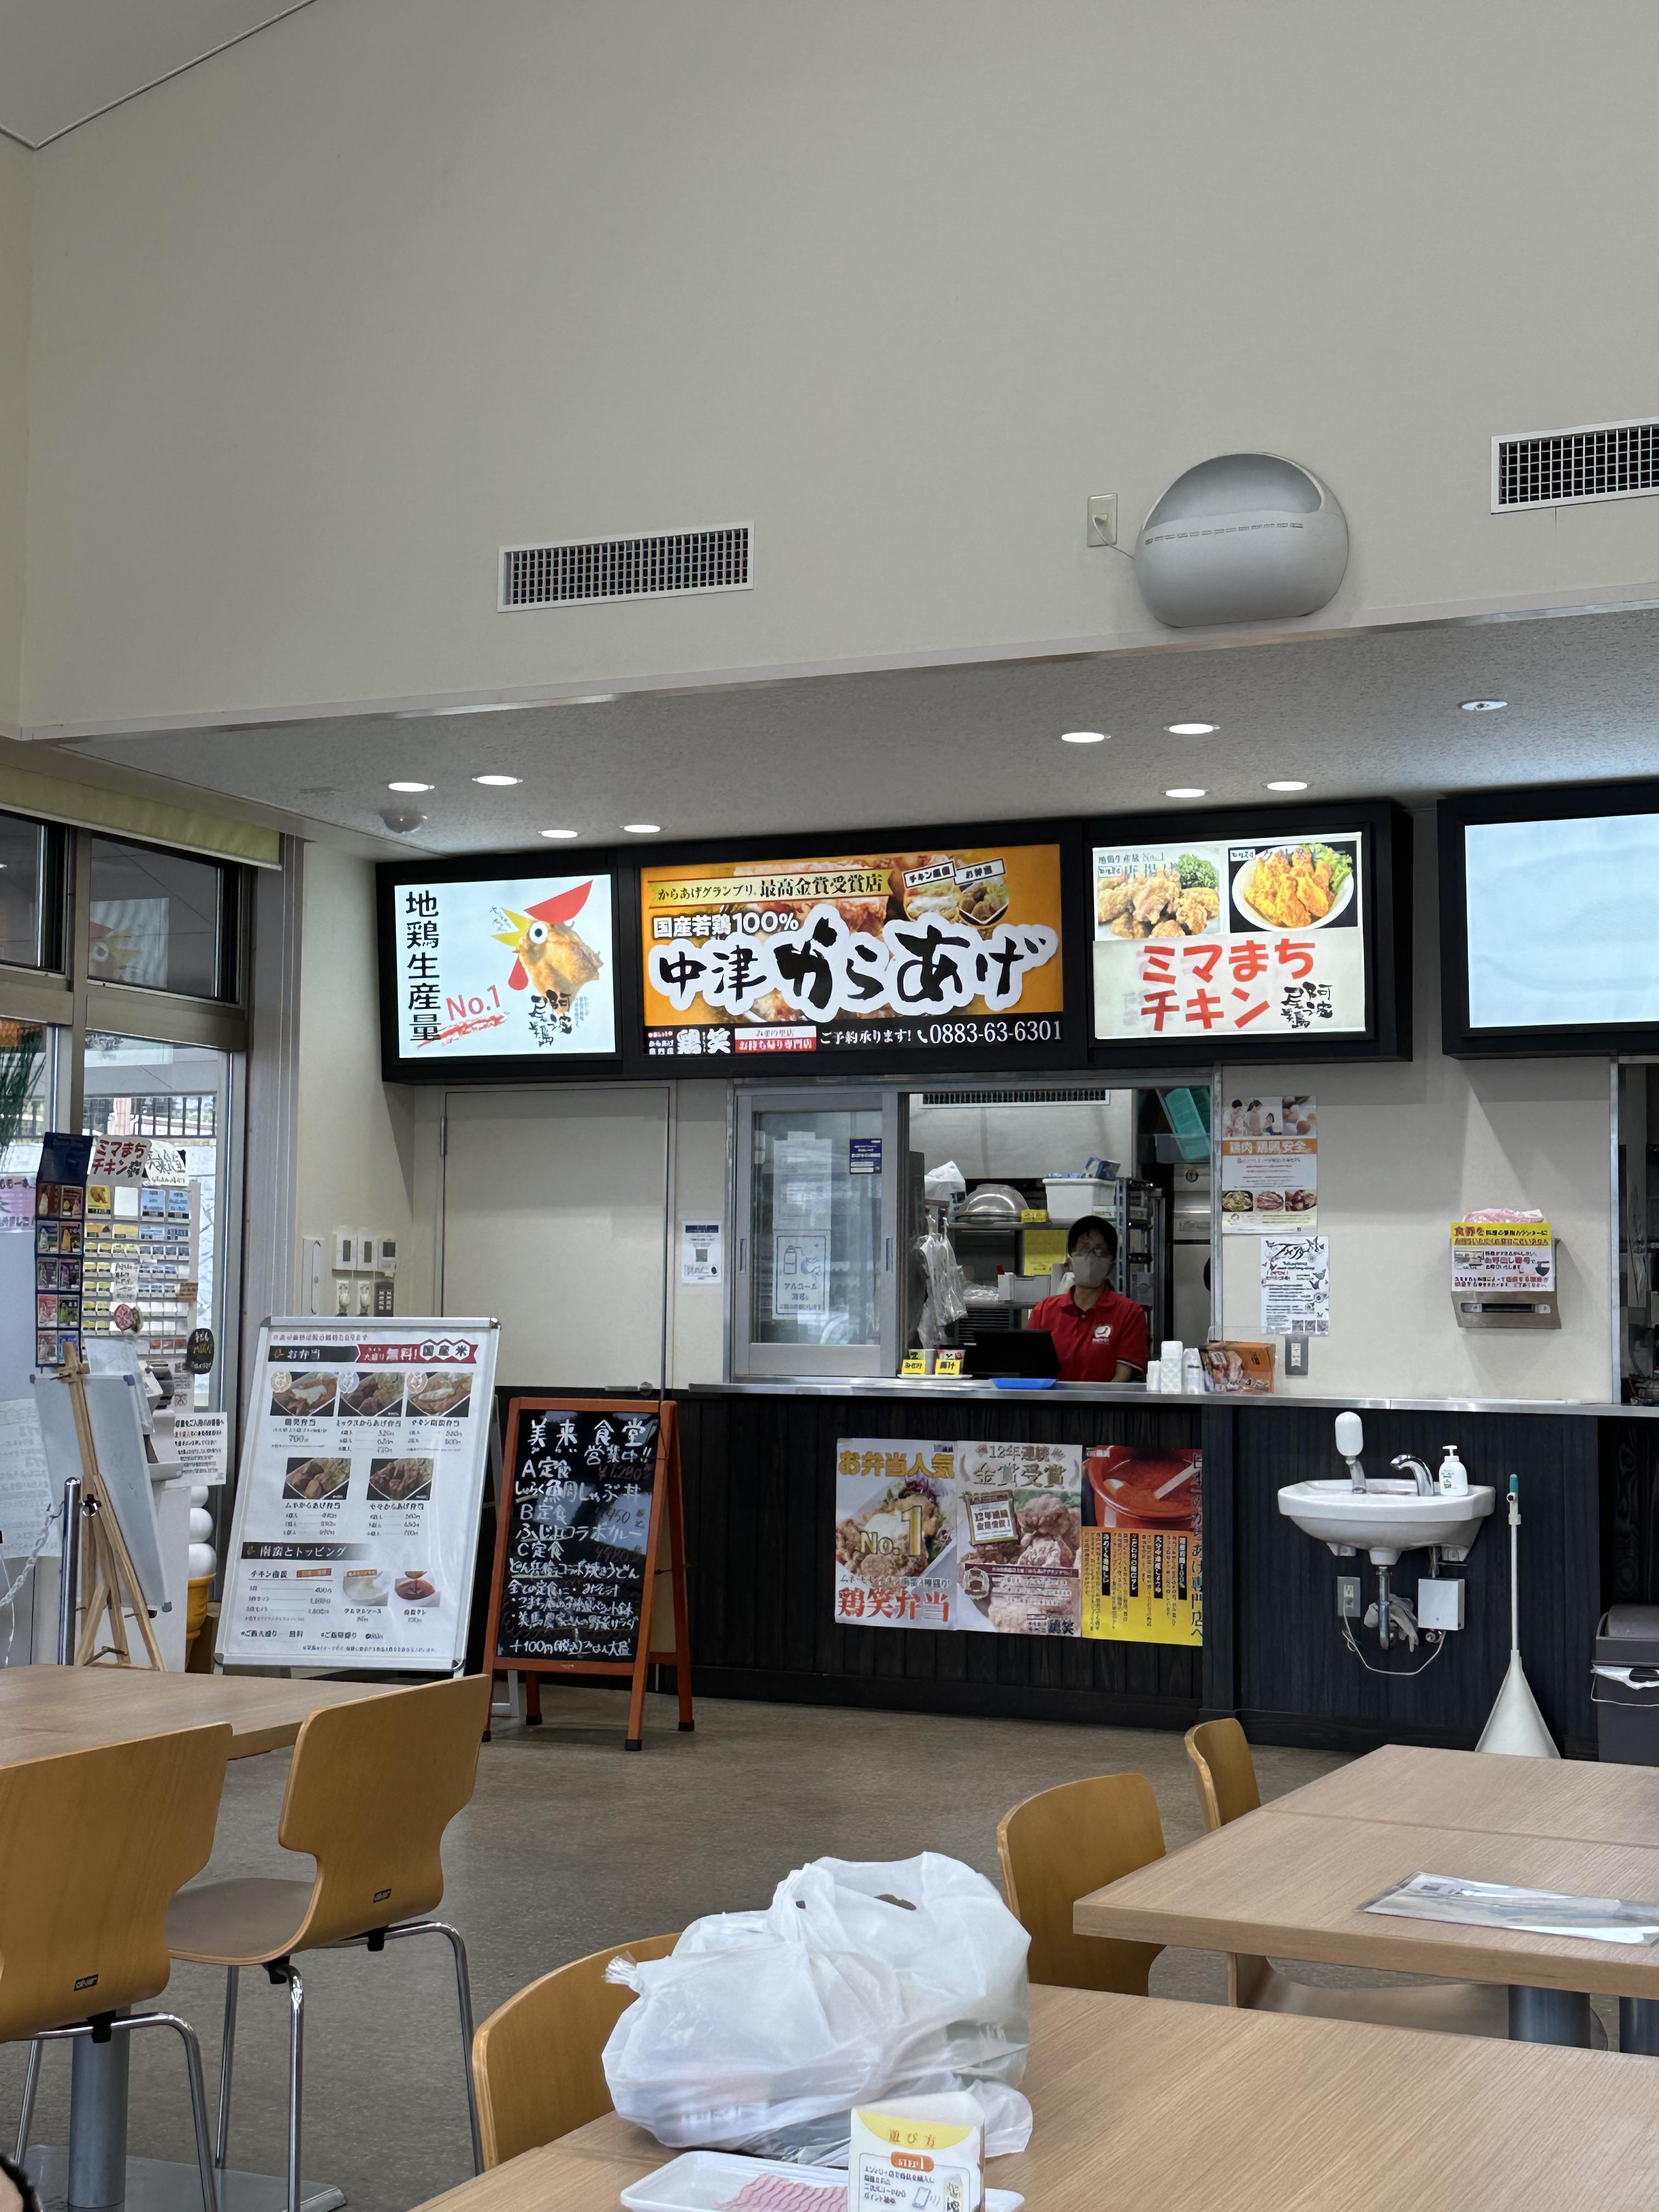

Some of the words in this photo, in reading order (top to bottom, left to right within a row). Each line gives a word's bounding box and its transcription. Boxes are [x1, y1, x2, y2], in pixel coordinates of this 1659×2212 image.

[405, 890, 441, 1041] 地鶏生産量
[1143, 938, 1316, 986] ミマまち
[445, 984, 501, 1021] No.1
[1140, 986, 1271, 1032] チキン
[929, 1021, 1062, 1045] 0883-63-6301
[92, 1159, 128, 1175] チキン
[97, 1139, 147, 1159] ミマまち
[521, 1455, 572, 1479] A定食
[838, 1450, 955, 1480] お弁当人気
[860, 1505, 923, 1556] No.1
[838, 1587, 950, 1623] 鶏笑弁当
